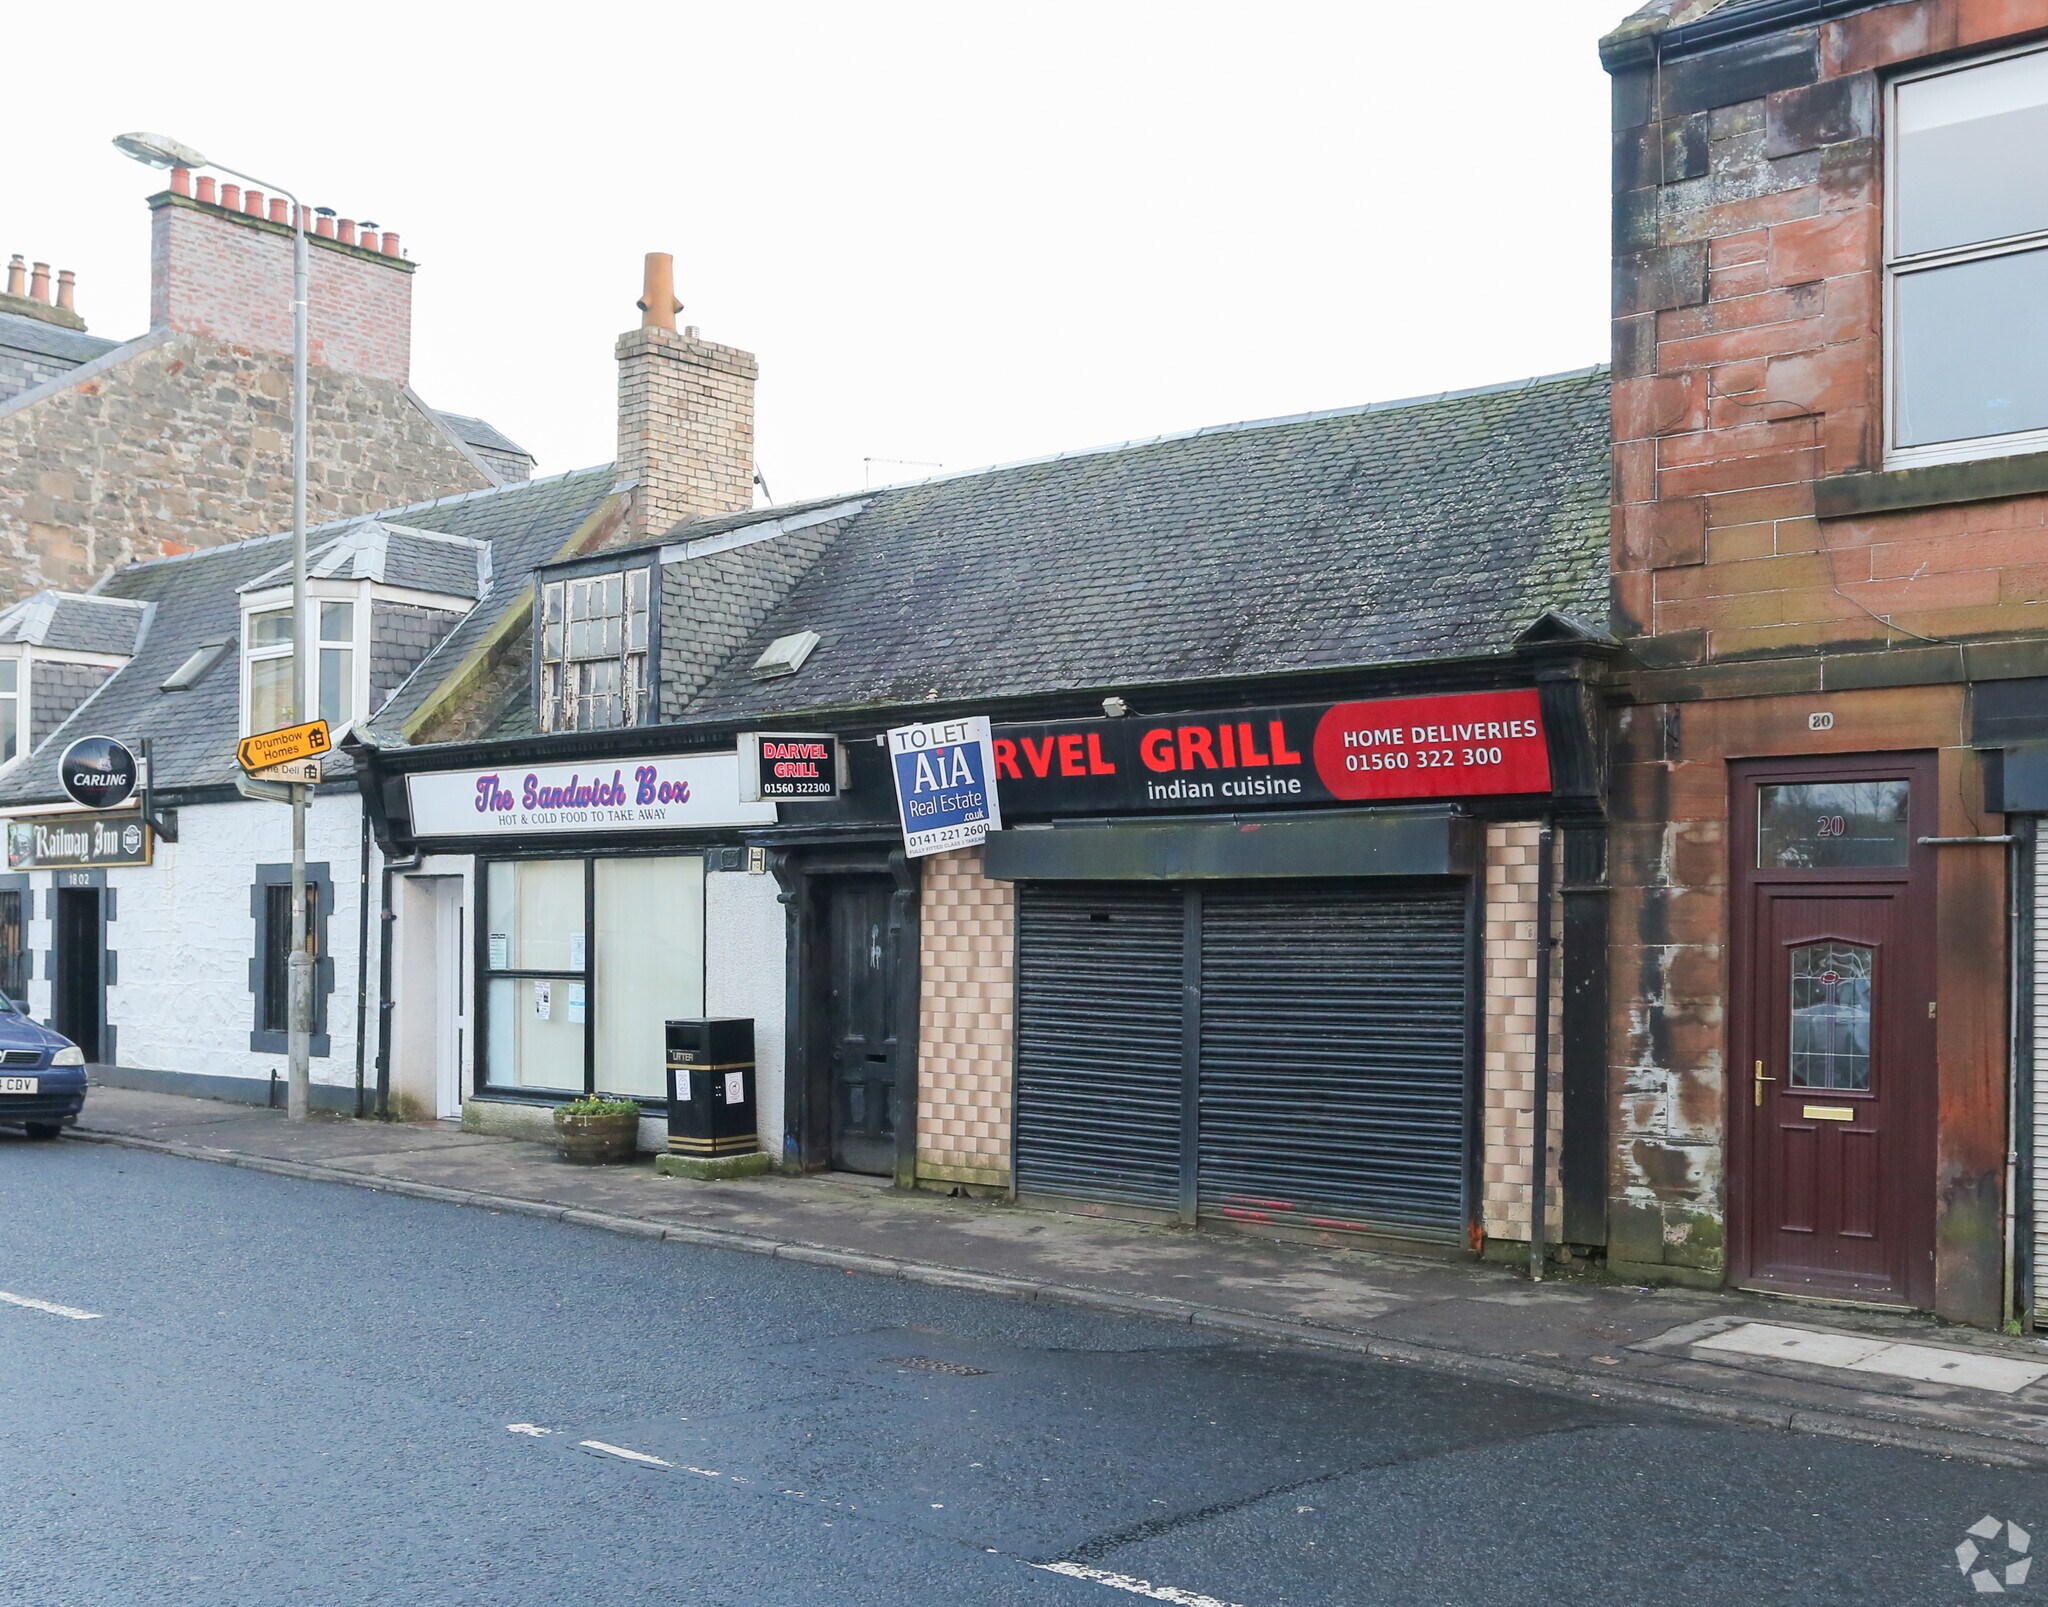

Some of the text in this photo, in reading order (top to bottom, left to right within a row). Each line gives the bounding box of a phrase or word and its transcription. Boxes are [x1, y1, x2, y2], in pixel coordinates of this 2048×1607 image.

[1812, 714, 1831, 729] 20
[254, 732, 303, 750] Drumbow
[895, 722, 969, 750] TO LET
[1343, 719, 1538, 748] HOME DELIVERIES
[263, 745, 300, 760] Homes
[763, 742, 828, 759] DARVEL
[993, 720, 1302, 779] RVEL GRILL
[1345, 747, 1503, 772] 01560 322 300
[282, 765, 300, 775] Dell
[774, 762, 820, 778] GRILL
[73, 773, 127, 787] CARLING
[475, 765, 691, 813] The Sandwich Box
[764, 783, 831, 794] 01560 322300
[1147, 775, 1301, 800] indian cuisine
[909, 790, 983, 818] Real Estate
[498, 808, 667, 826] HOT & COLD FOOD TO TAKE AWAY
[963, 808, 985, 822] .co.uk
[1817, 815, 1845, 836] 20
[34, 821, 118, 862] Railway Inn
[910, 823, 990, 847] 0141 221 2600
[69, 873, 90, 886] 1802
